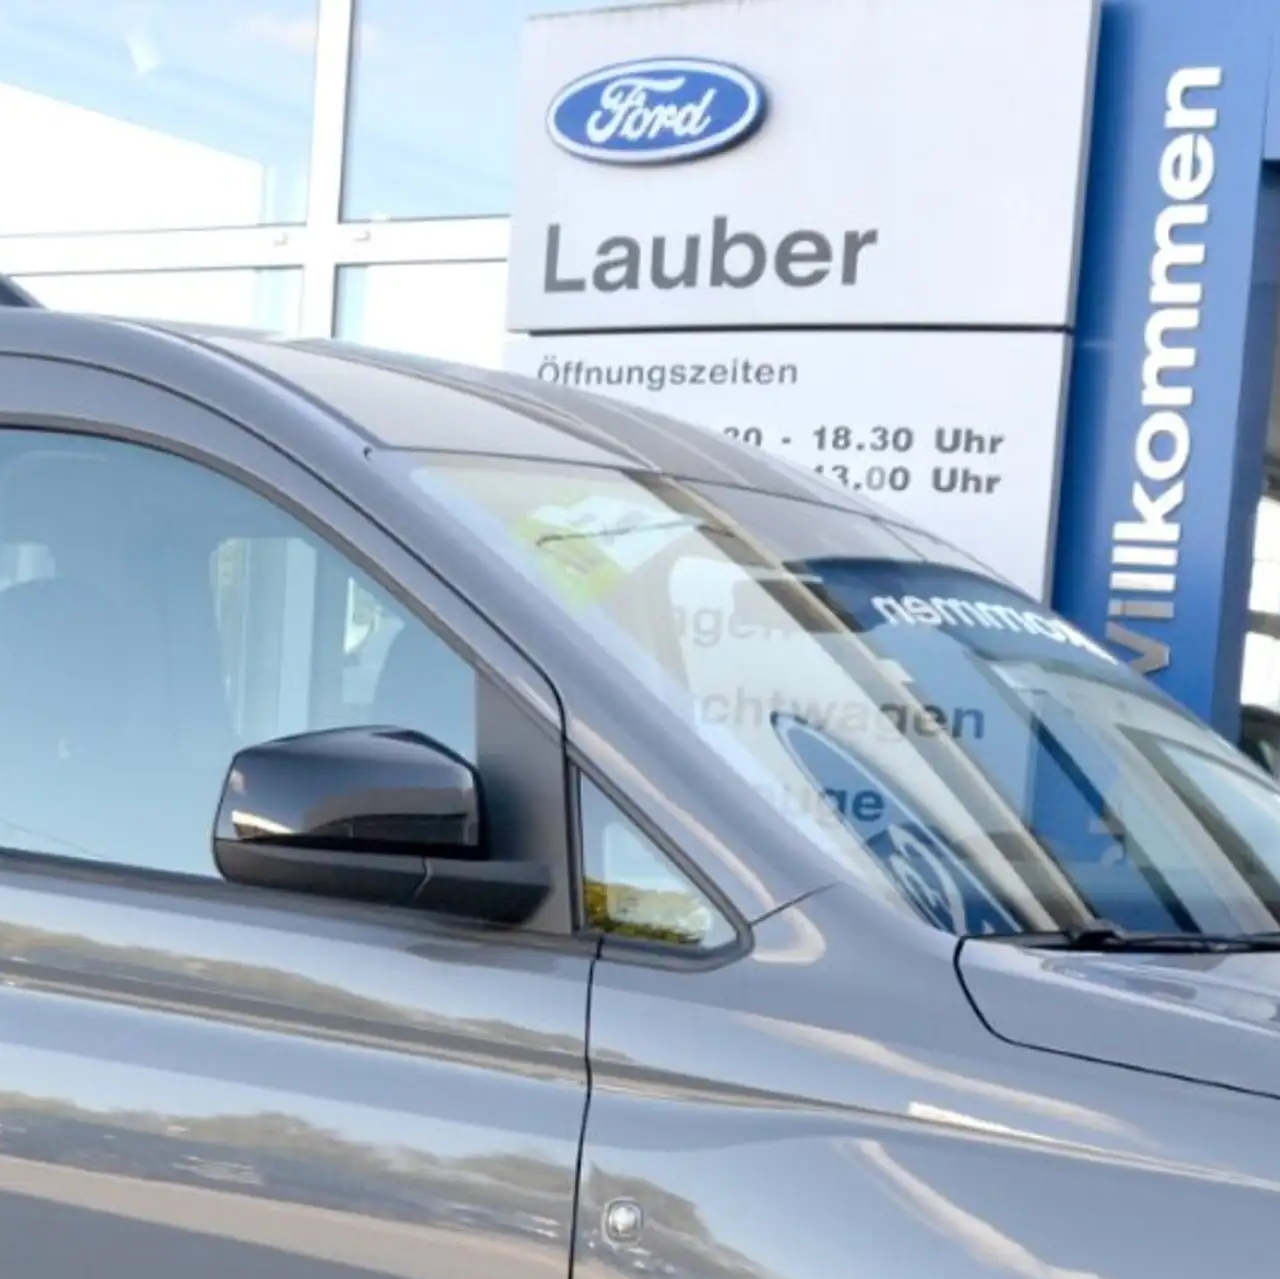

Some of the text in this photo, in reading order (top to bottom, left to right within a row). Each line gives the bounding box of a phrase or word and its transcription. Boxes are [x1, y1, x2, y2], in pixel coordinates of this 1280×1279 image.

[585, 75, 717, 144] Ford
[543, 214, 879, 294] Lauber
[536, 354, 799, 391] Öffnungszeiten
[812, 425, 914, 453] 18.30
[933, 427, 1005, 455] Uhr
[814, 464, 1002, 494] 3.00 Uhr
